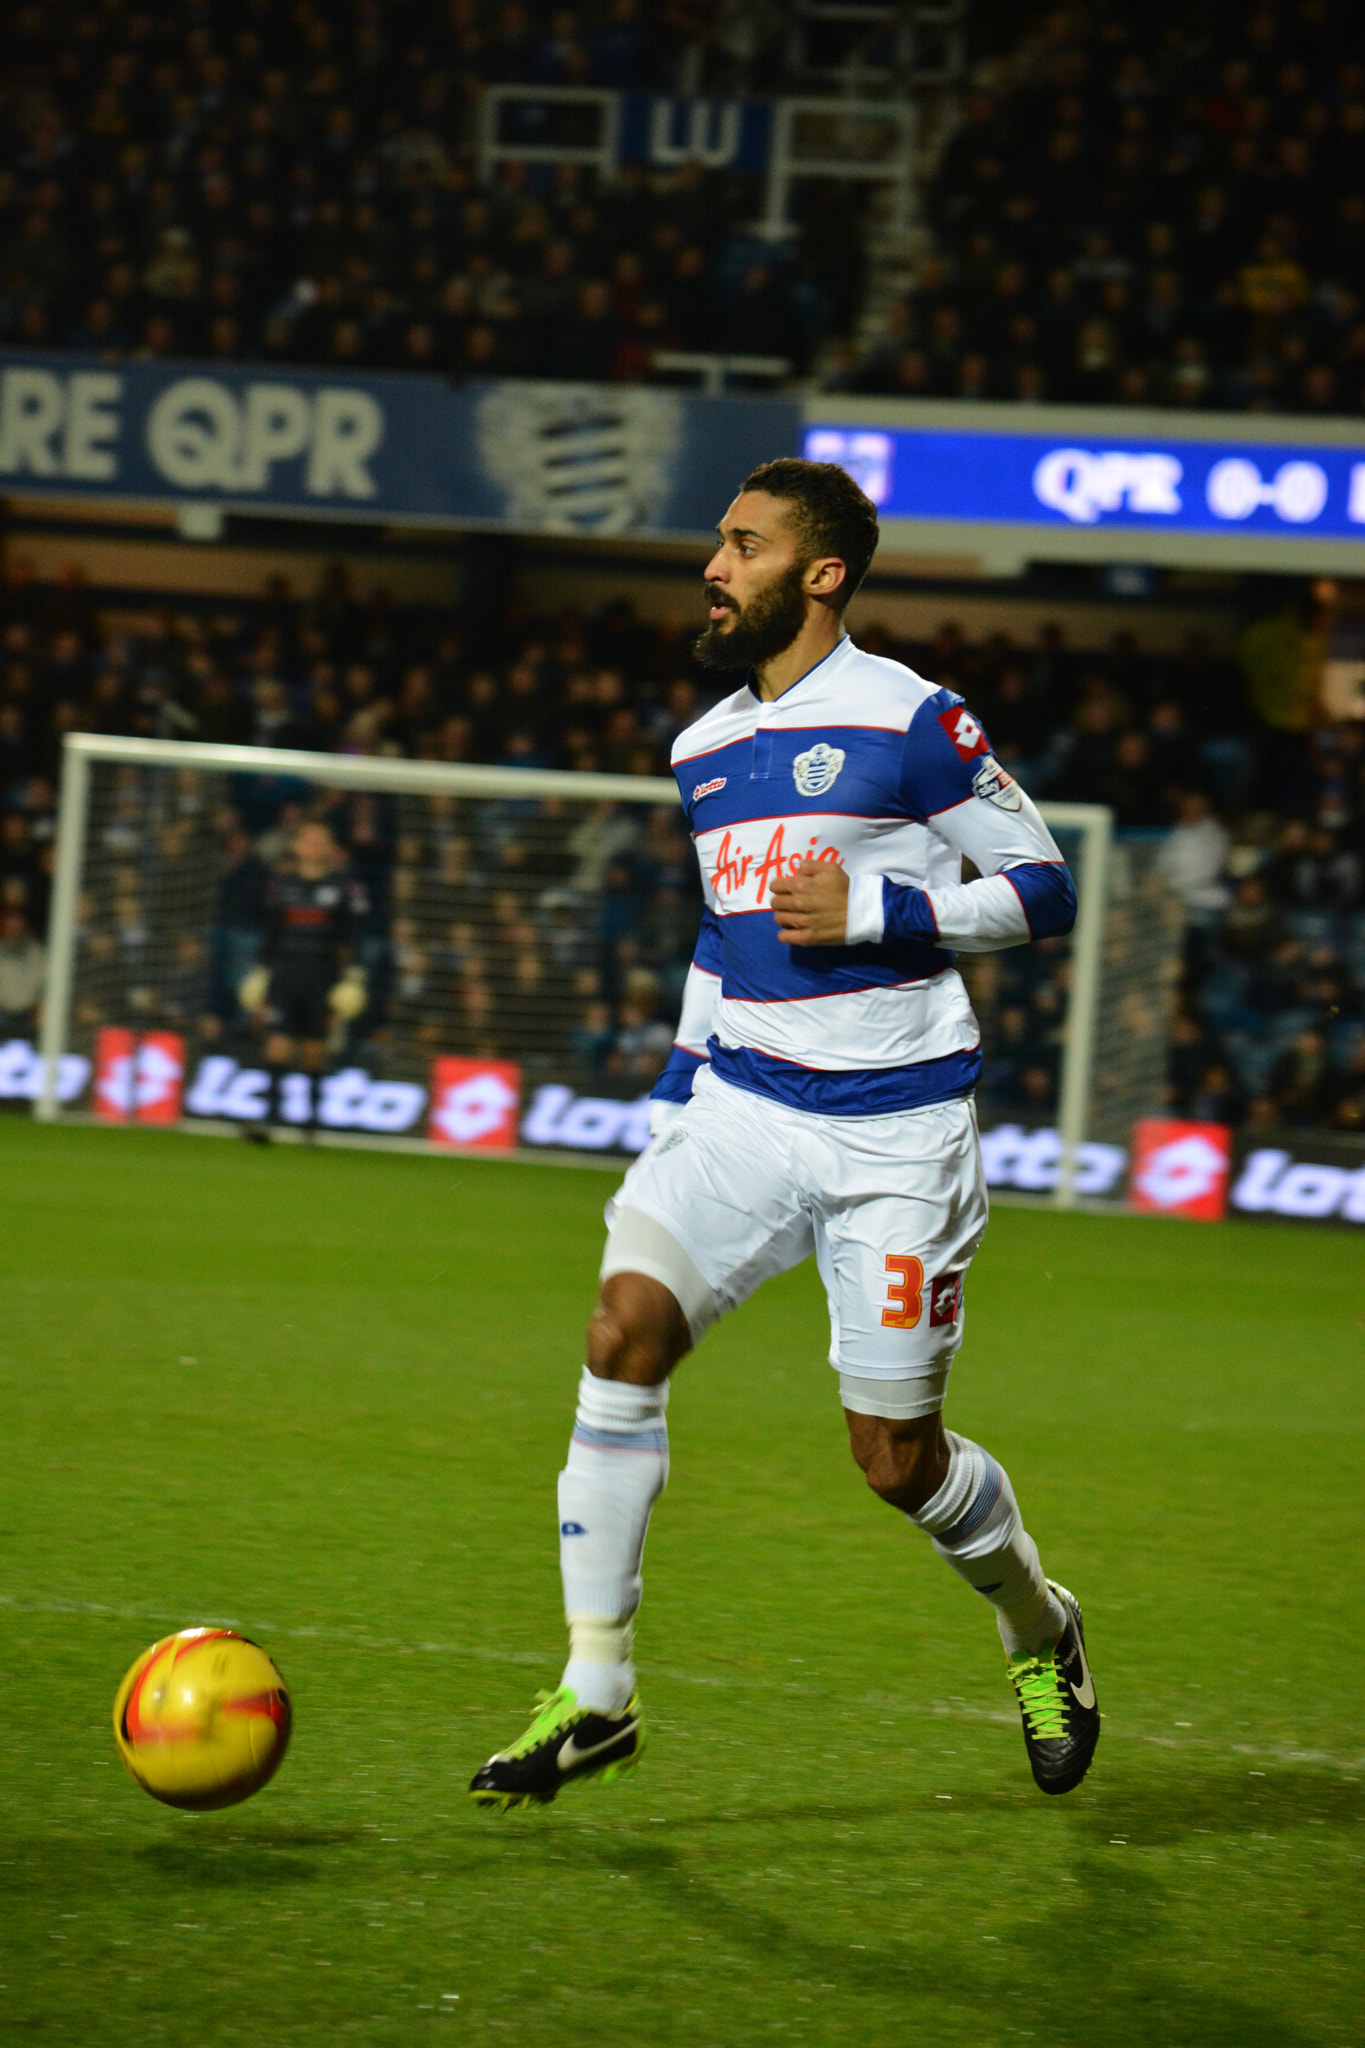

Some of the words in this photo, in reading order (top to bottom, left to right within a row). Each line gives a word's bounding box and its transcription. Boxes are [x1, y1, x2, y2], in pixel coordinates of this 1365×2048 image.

[651, 98, 740, 167] W
[147, 377, 383, 500] QPR
[1032, 449, 1183, 523] QPR
[1206, 458, 1328, 523] 0-0
[710, 830, 754, 895] Air
[754, 822, 845, 904] Asia
[881, 1253, 924, 1329] 3
